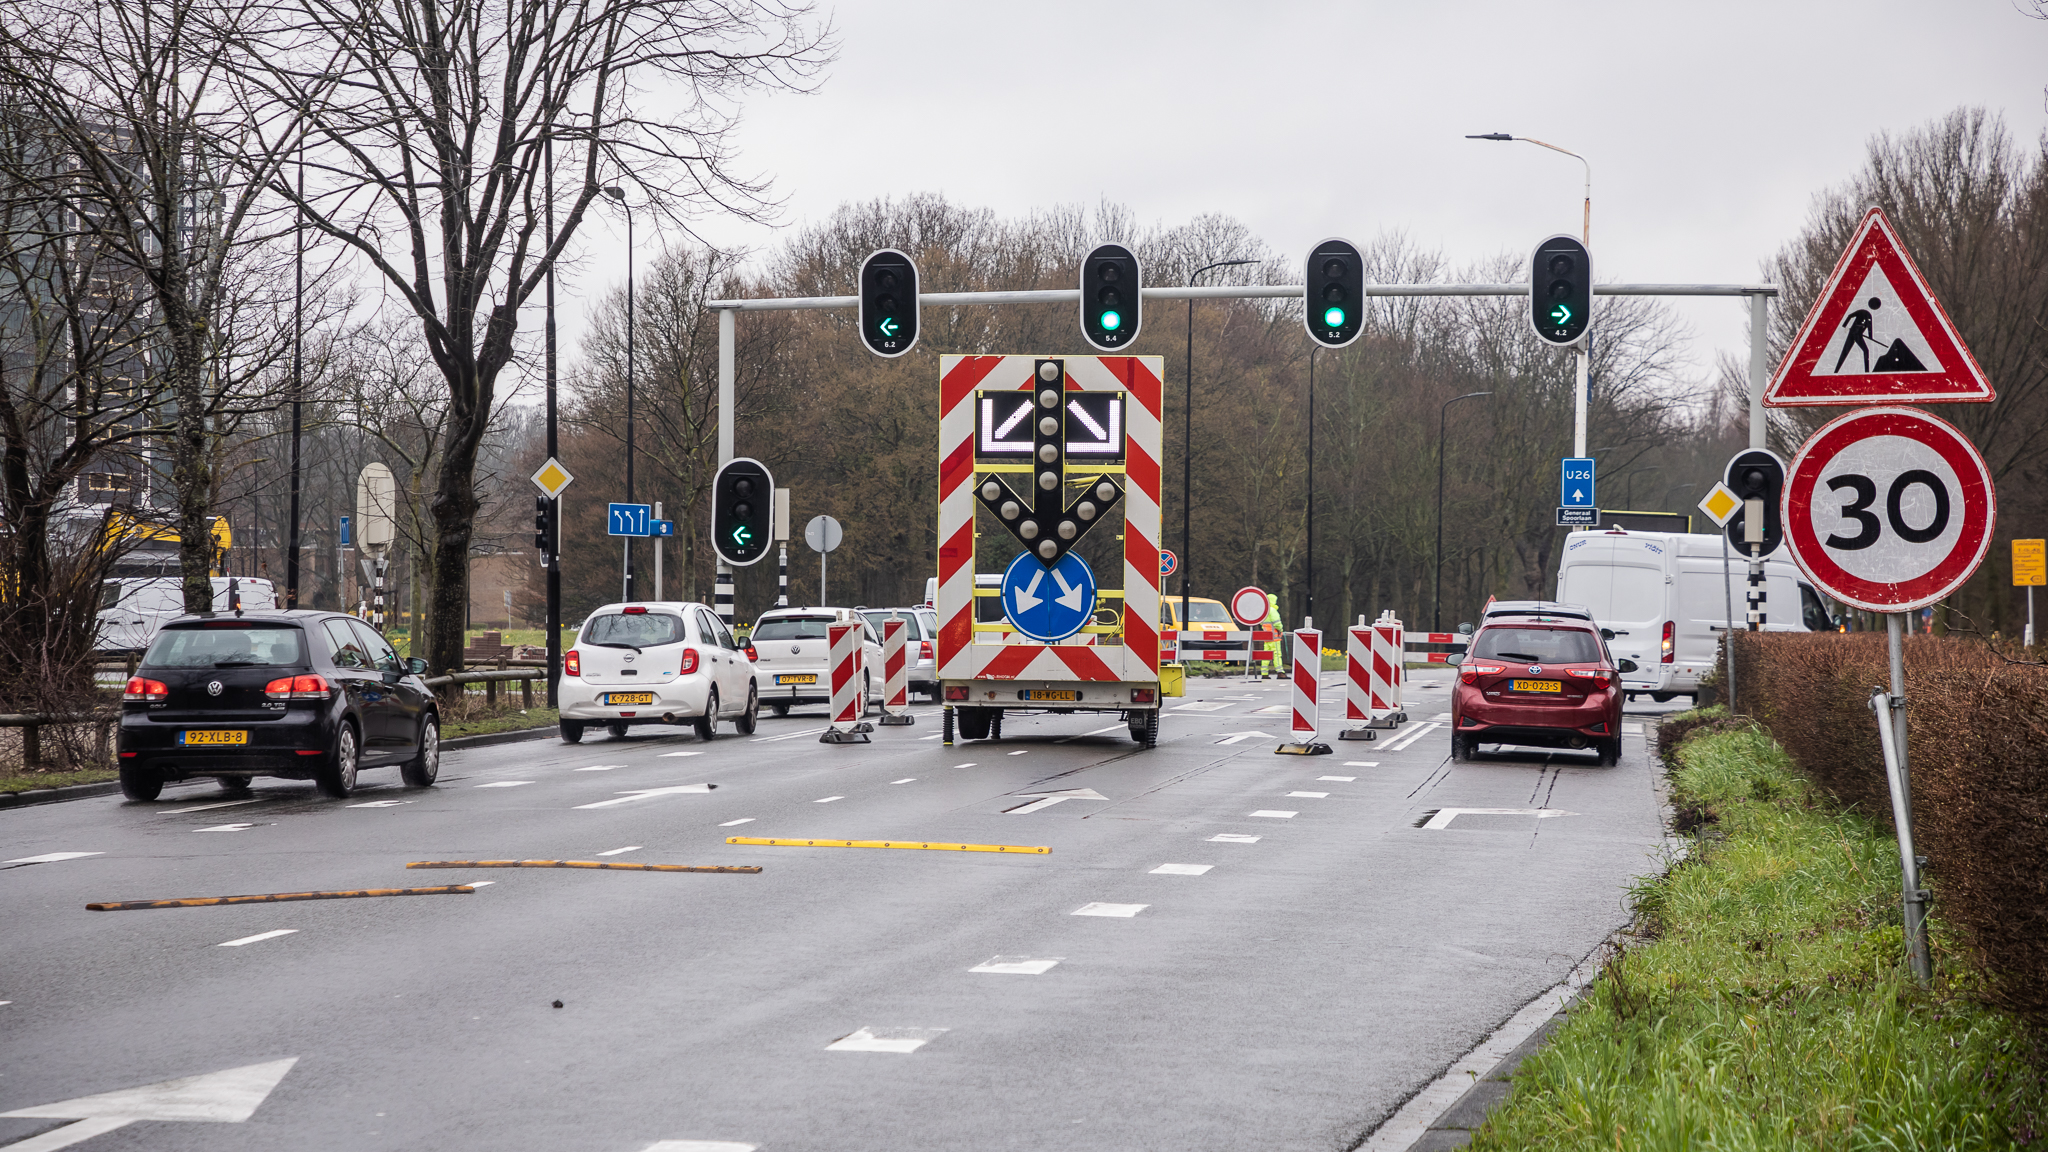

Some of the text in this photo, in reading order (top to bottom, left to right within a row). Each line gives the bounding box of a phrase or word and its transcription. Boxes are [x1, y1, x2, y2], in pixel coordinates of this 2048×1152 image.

[1566, 470, 1591, 480] U26
[1825, 469, 1950, 551] 30
[781, 675, 814, 683] 07-TVR-8
[1516, 681, 1558, 690] XD-023-S
[611, 694, 649, 702] K-728-GT
[1032, 691, 1070, 700] 18-WG-LL
[189, 732, 243, 743] 92-XLB-8
